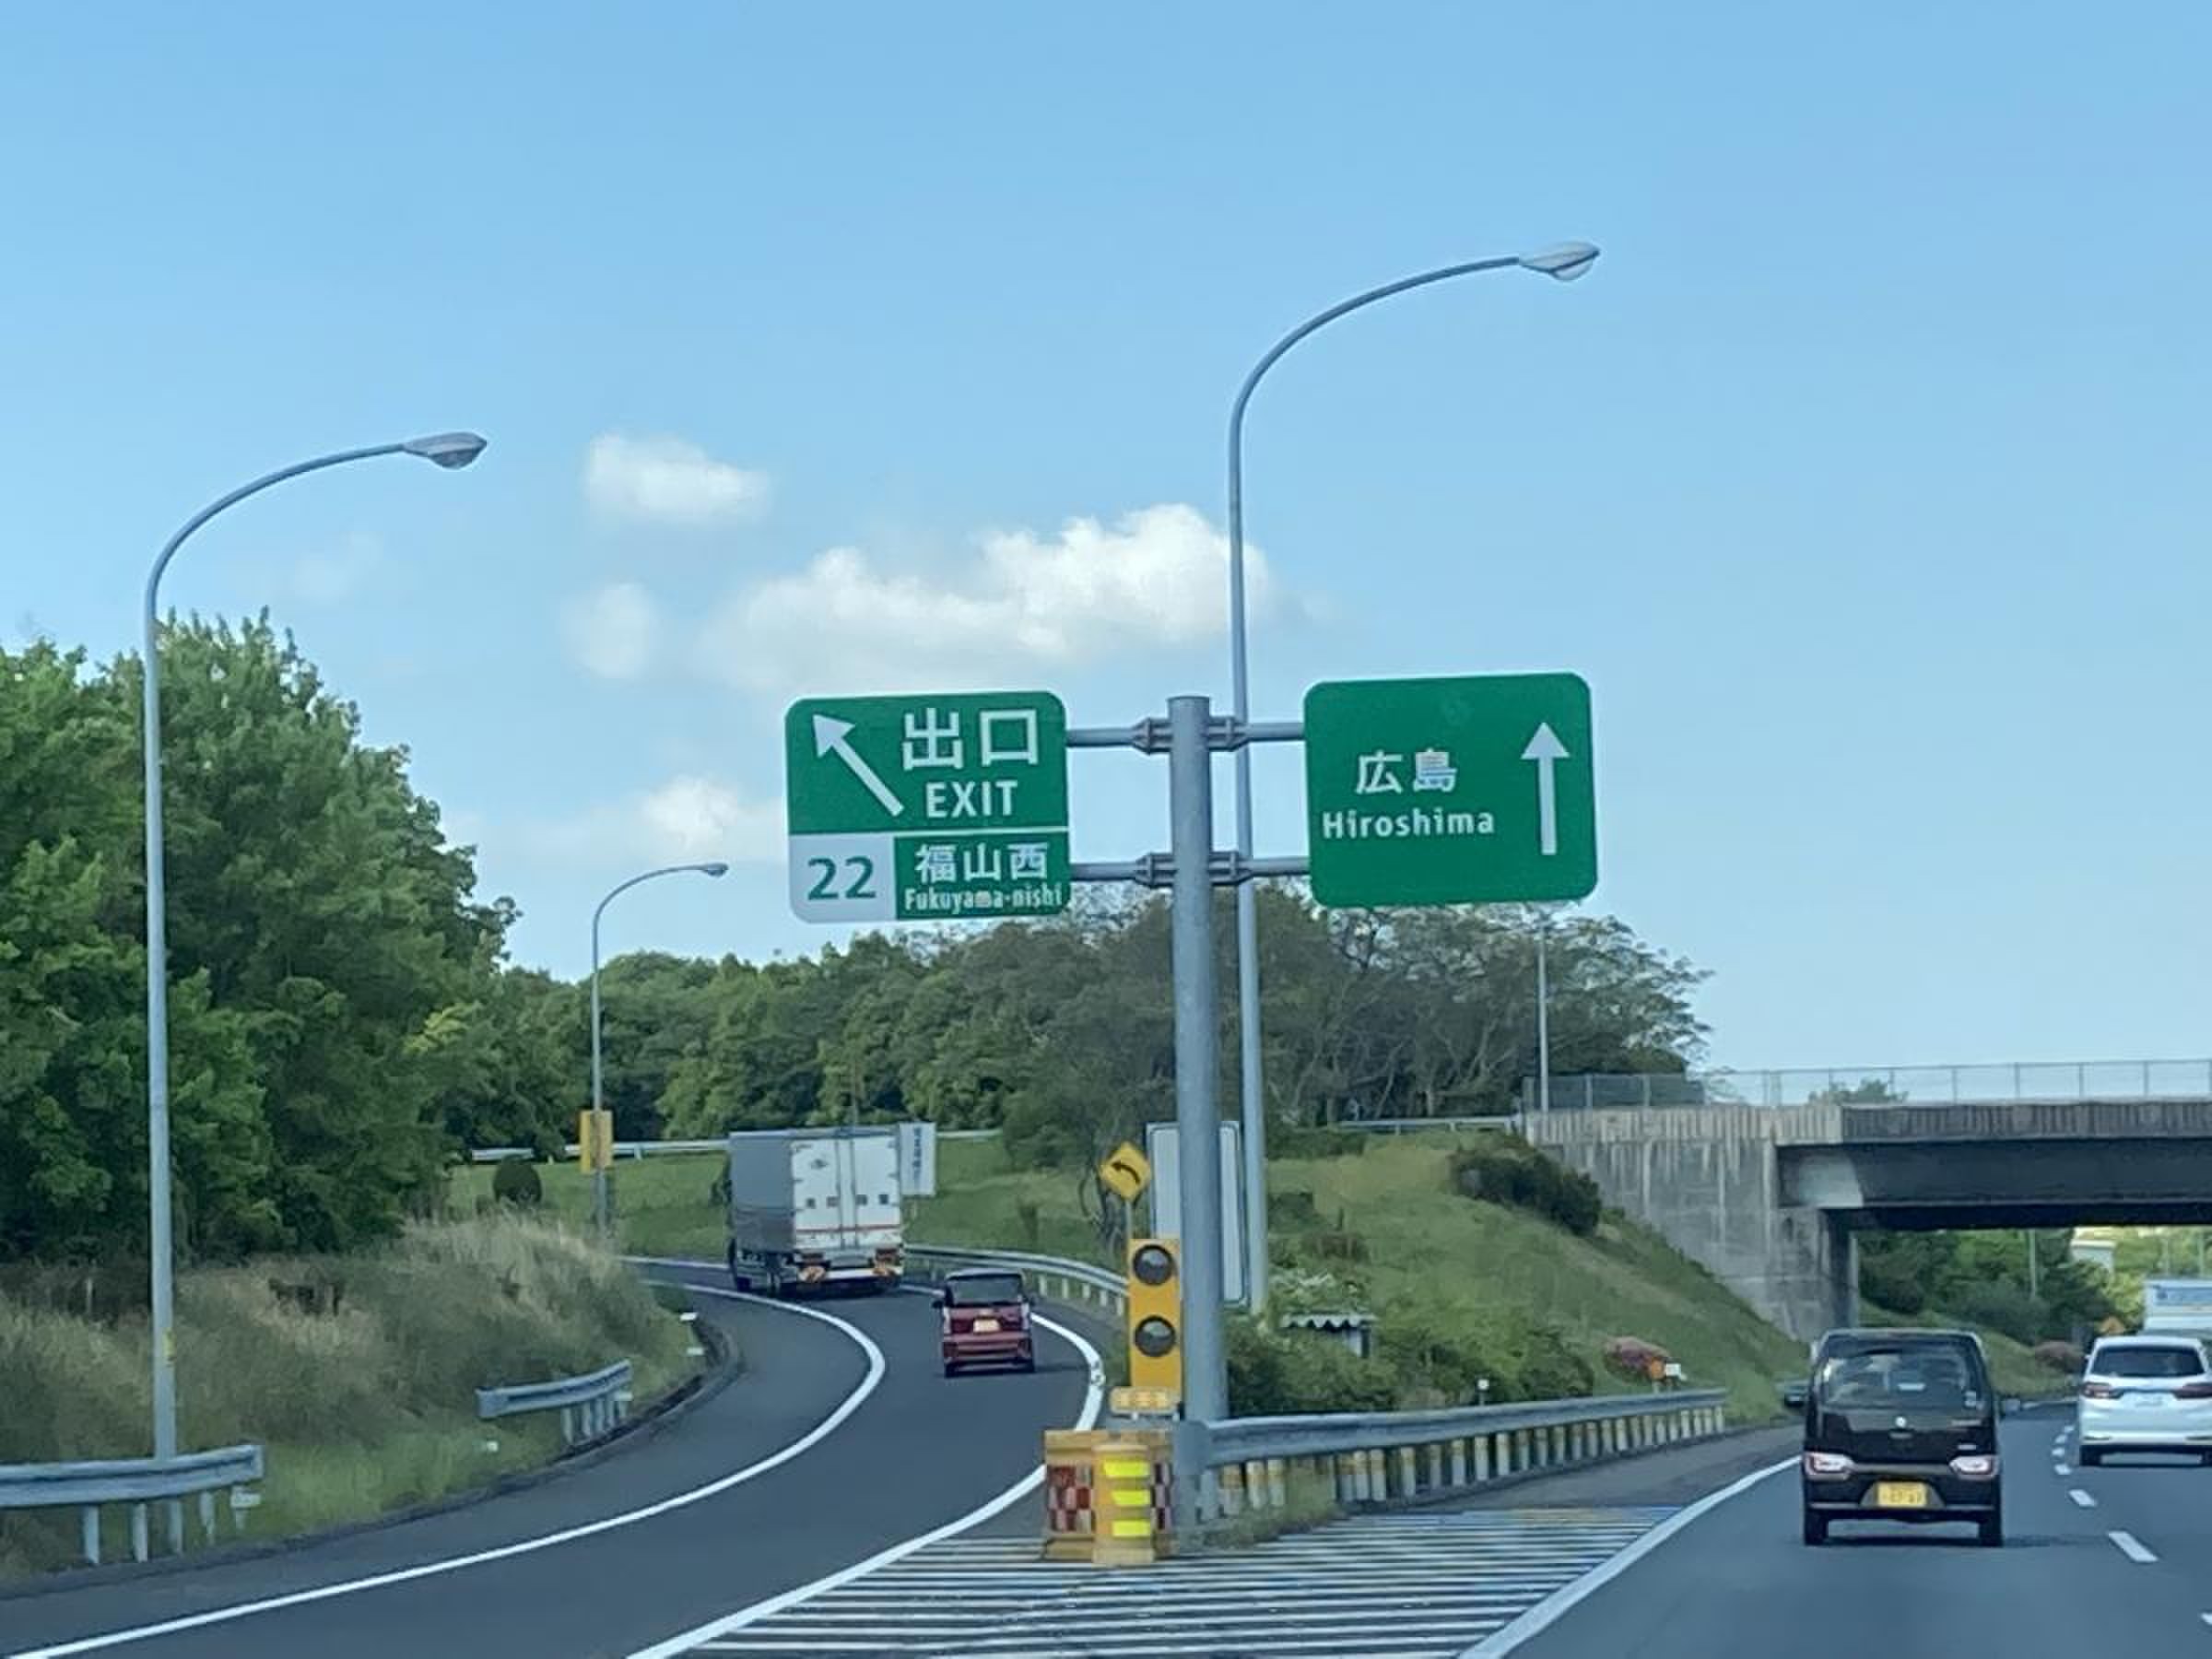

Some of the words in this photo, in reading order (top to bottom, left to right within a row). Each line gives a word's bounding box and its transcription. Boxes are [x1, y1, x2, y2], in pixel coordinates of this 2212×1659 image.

[901, 707, 1039, 771] 出口
[1355, 747, 1458, 794] 広島
[925, 780, 1018, 818] EXIT
[1322, 807, 1495, 839] Hiroshima
[807, 856, 877, 900] 22
[914, 841, 1049, 884] 福山西
[904, 882, 1063, 915] Fukuyama-nishi
